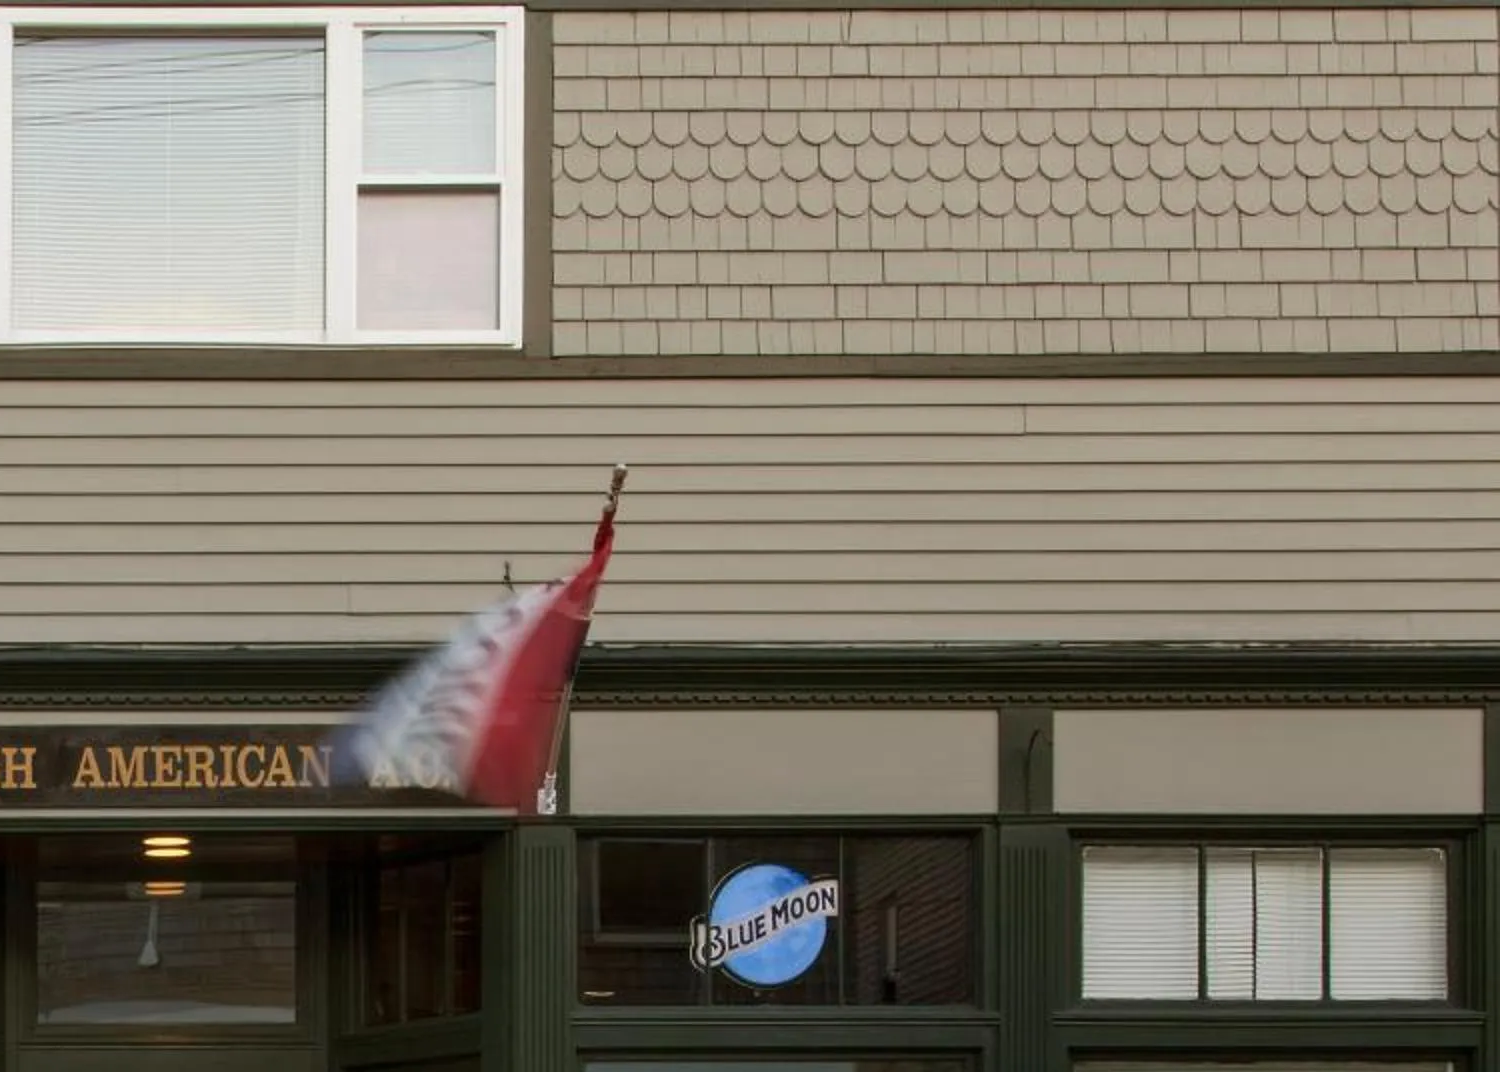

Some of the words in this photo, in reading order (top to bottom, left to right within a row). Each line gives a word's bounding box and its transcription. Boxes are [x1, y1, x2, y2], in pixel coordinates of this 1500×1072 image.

[72, 746, 333, 790] AMERICAN
[699, 915, 767, 961] BLUE
[771, 887, 836, 931] MOON
